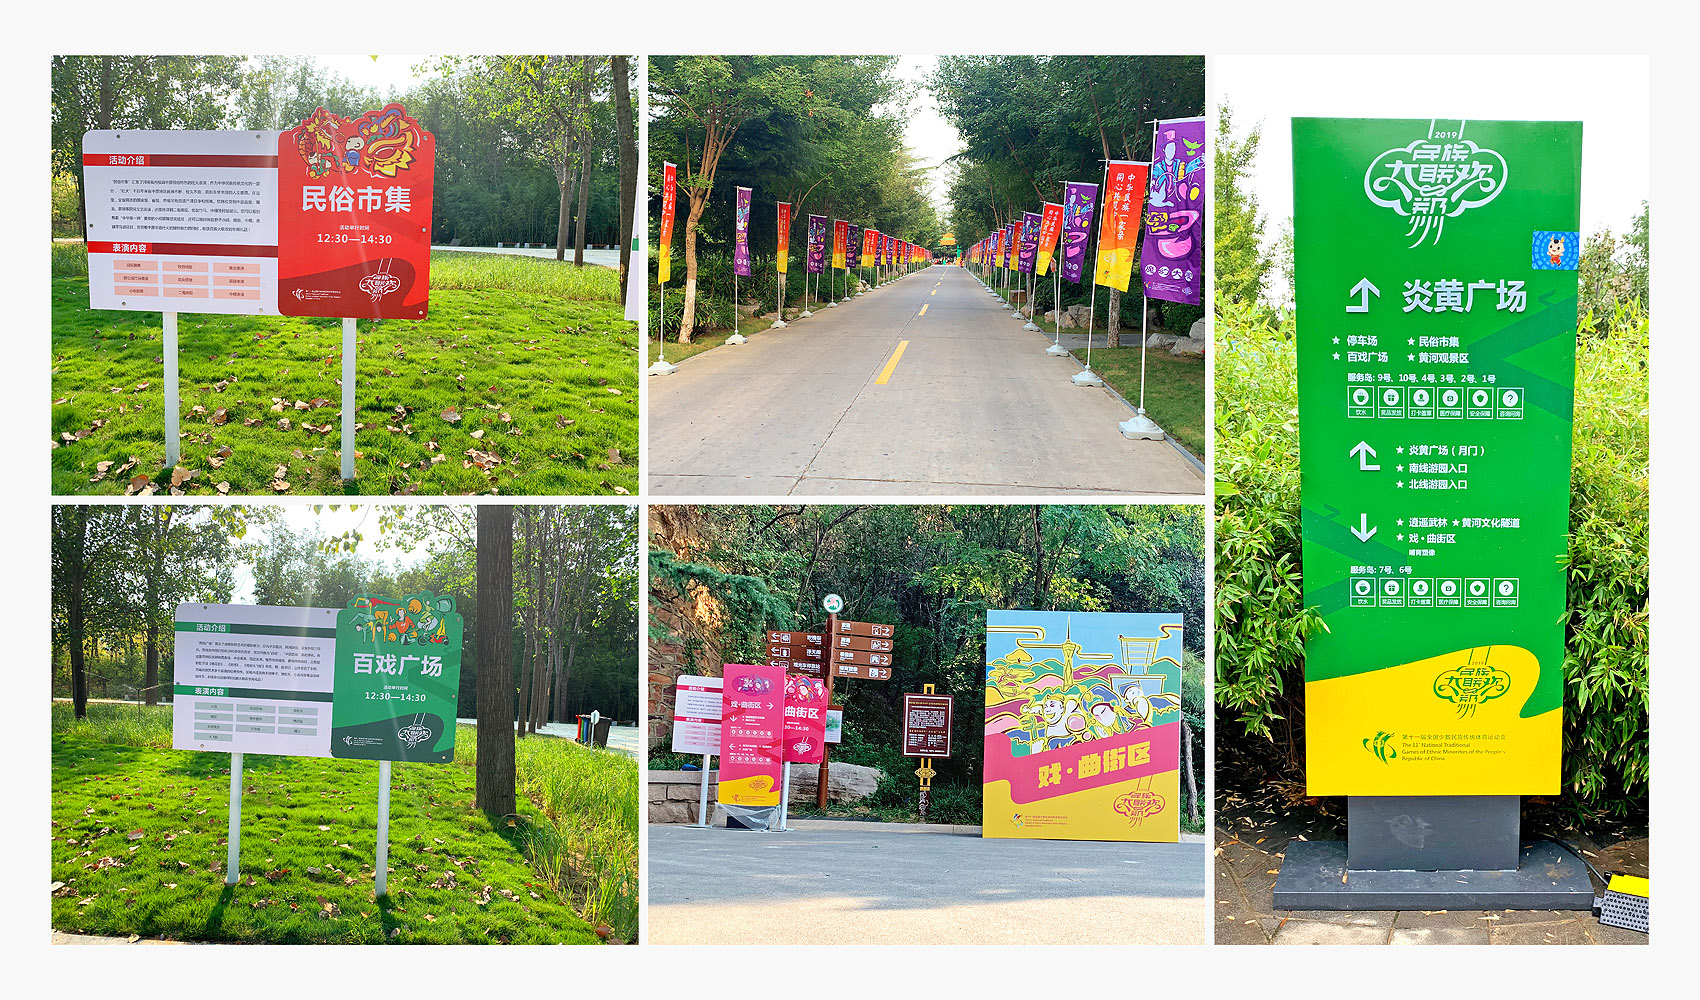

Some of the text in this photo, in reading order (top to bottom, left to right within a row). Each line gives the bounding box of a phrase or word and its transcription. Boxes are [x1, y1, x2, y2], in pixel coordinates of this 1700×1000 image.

[1435, 131, 1457, 139] 2019
[1412, 144, 1469, 162] 民族
[109, 155, 145, 165] 活动介绍
[1373, 160, 1496, 203] 大联欢
[302, 185, 412, 214] 民俗市集
[112, 243, 147, 253] 表演内容
[1402, 279, 1527, 313] 炎黄广场
[1347, 335, 1378, 348] 停车场
[1418, 336, 1460, 348] 民俗市集
[1347, 351, 1389, 364] 百戏广场
[1418, 352, 1470, 364] 黄河观景区
[1409, 463, 1468, 474] 南线游园入口
[1409, 479, 1468, 490] 北线游园入口
[1408, 517, 1521, 528] 逍遥武林 黄河文化隧道
[196, 623, 226, 632] 活动介绍
[353, 652, 443, 677] 百戏广场
[194, 687, 225, 696] 表演内容
[785, 706, 820, 720] 曲街区
[1038, 741, 1151, 789] 戏·曲街区
